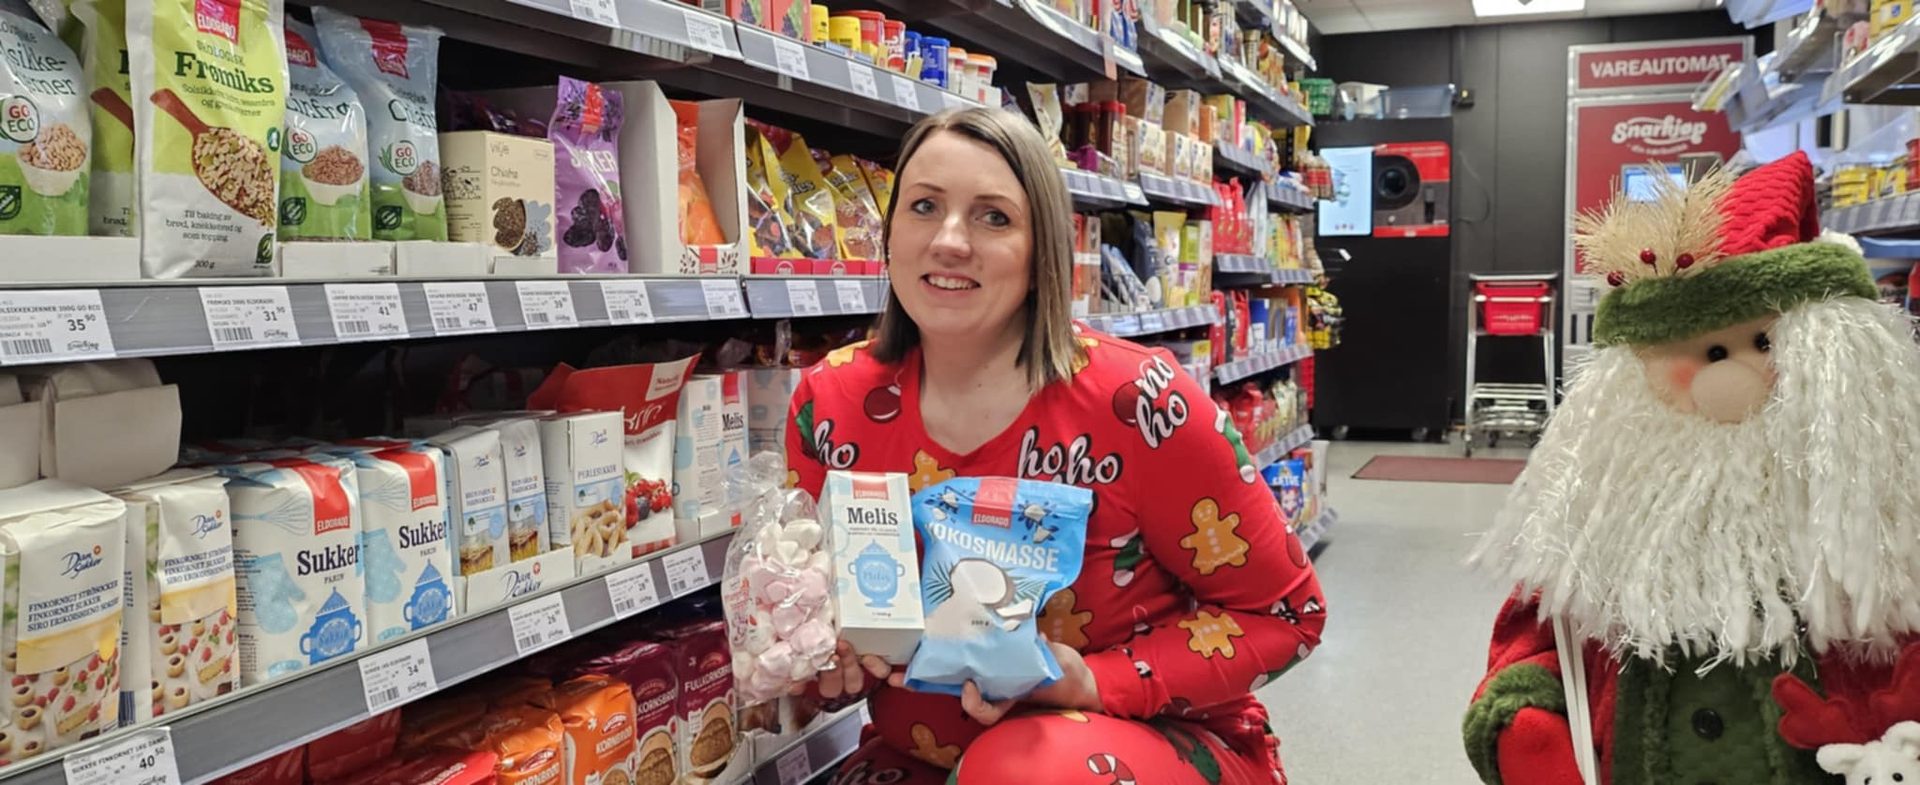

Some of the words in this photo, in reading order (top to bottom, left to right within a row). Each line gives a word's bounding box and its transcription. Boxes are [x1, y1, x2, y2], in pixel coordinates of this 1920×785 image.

[174, 51, 275, 93] Frømiks
[1590, 54, 1731, 78] VAREAUTOMAT
[9, 105, 31, 119] GO
[7, 118, 36, 134] ECO
[1611, 115, 1708, 144] Snarkjøp
[292, 132, 309, 144] GO
[292, 142, 314, 155] ECO
[395, 146, 412, 158] GO
[394, 156, 416, 168] ECO
[262, 311, 278, 321] 31
[67, 319, 86, 331] 35
[1135, 389, 1189, 450] ho
[813, 419, 859, 469] ho
[1018, 425, 1068, 477] ho
[1065, 433, 1123, 485] ho
[316, 516, 350, 533] ELDORADO
[847, 507, 898, 525] Melis
[973, 514, 1010, 527] ELDORADO
[398, 520, 448, 549] Sukker
[296, 544, 361, 577] Sukker
[407, 664, 419, 677] 34
[138, 754, 156, 769] 40
[154, 747, 166, 756] 50
